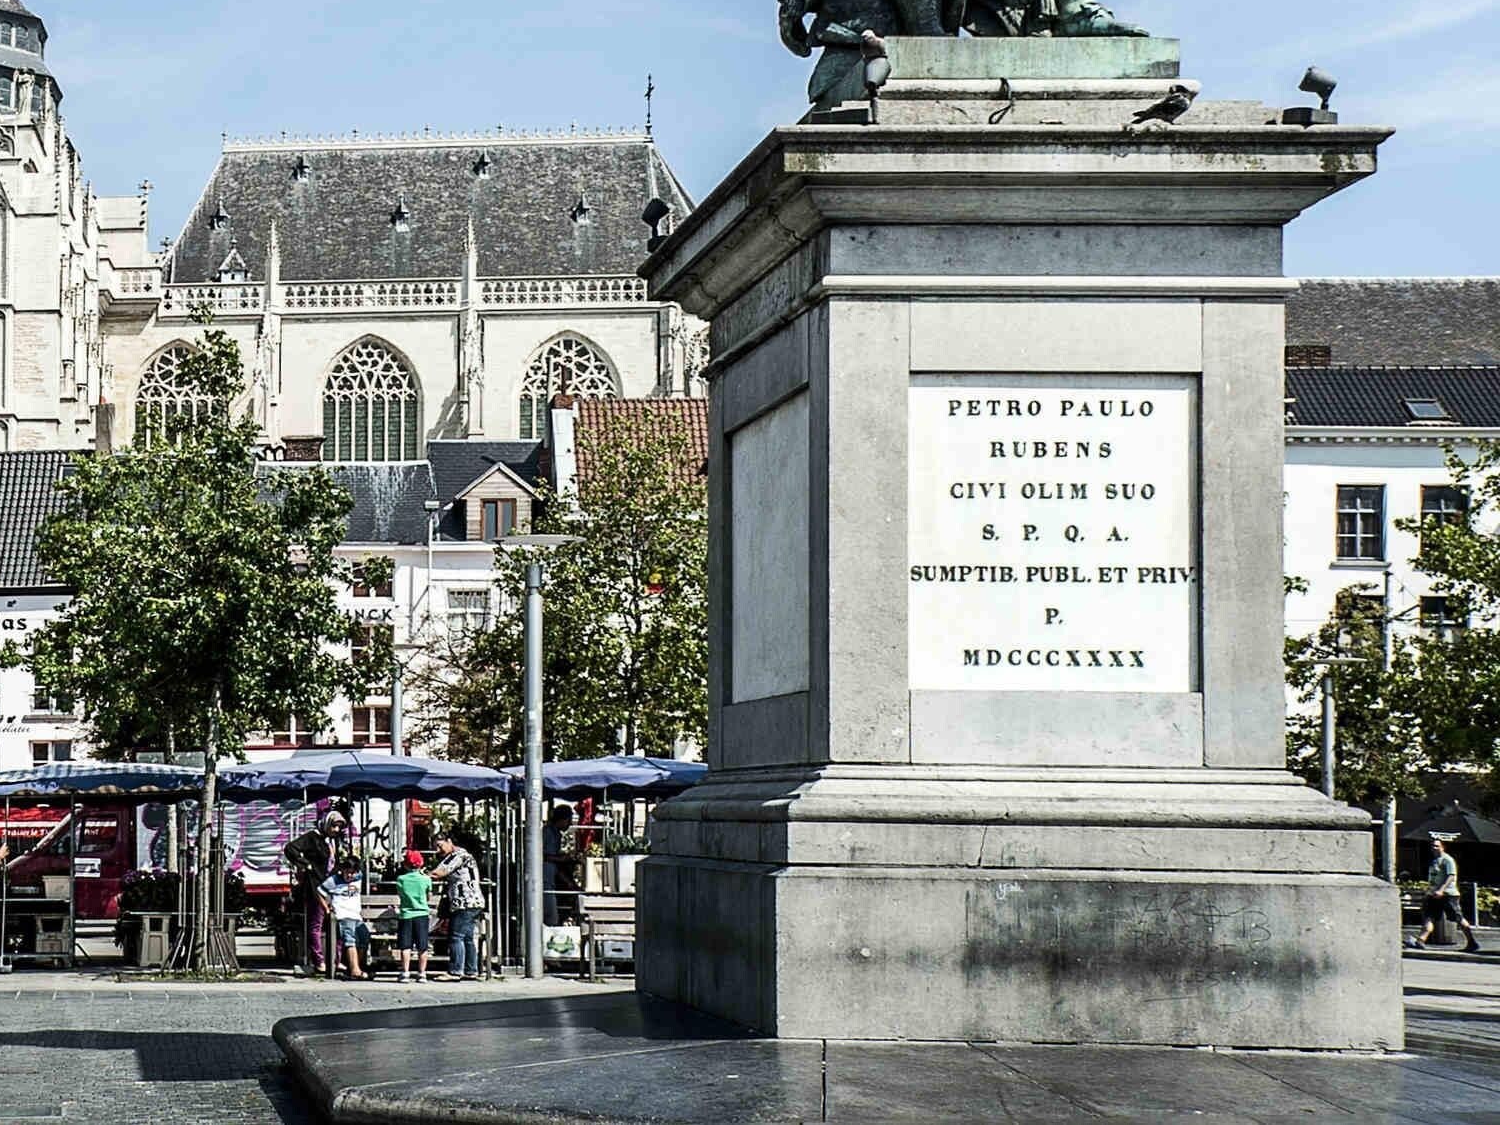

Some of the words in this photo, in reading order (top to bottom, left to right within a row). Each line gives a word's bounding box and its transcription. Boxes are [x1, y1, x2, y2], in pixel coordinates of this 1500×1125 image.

[948, 400, 1042, 417] PETRO
[1060, 400, 1154, 417] PAULO
[990, 441, 1112, 458] RUBENS
[949, 482, 1007, 499] CIVI
[1020, 483, 1088, 500] OLIM
[1105, 483, 1156, 500] SUO
[982, 524, 1000, 541] S.
[1023, 525, 1040, 541] P.
[1064, 525, 1085, 542] Q.
[1106, 526, 1129, 542] A.
[910, 566, 1018, 583] SUMPTIB.
[1025, 567, 1091, 583] PUBL.
[1098, 567, 1128, 584] ET
[1137, 567, 1197, 584] PRIV.
[1044, 608, 1063, 625] P.
[963, 649, 1145, 667] MDCCCXXXX
